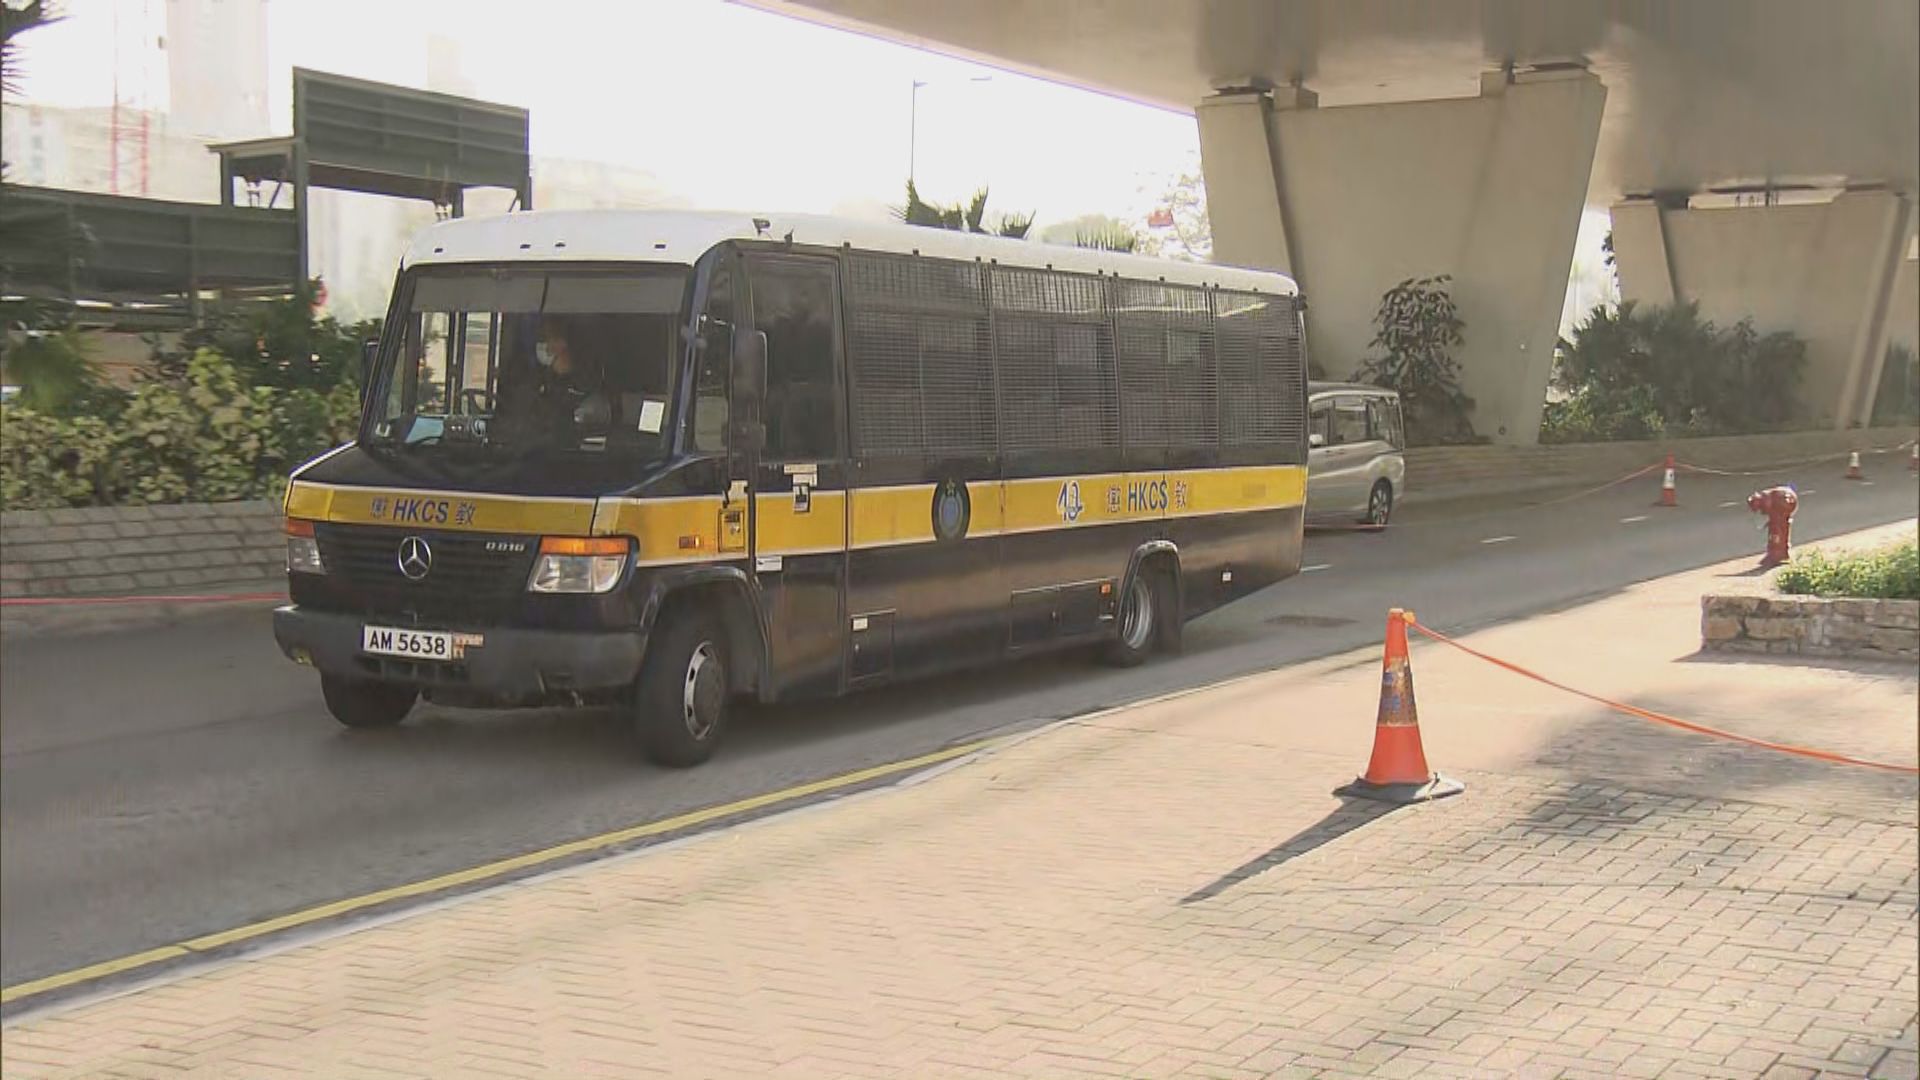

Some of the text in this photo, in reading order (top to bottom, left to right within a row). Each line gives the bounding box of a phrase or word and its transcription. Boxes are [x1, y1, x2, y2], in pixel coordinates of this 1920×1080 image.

[1128, 480, 1168, 511] HKCS
[393, 499, 448, 522] HKCS
[370, 631, 392, 650] AM
[398, 634, 446, 655] 5638
